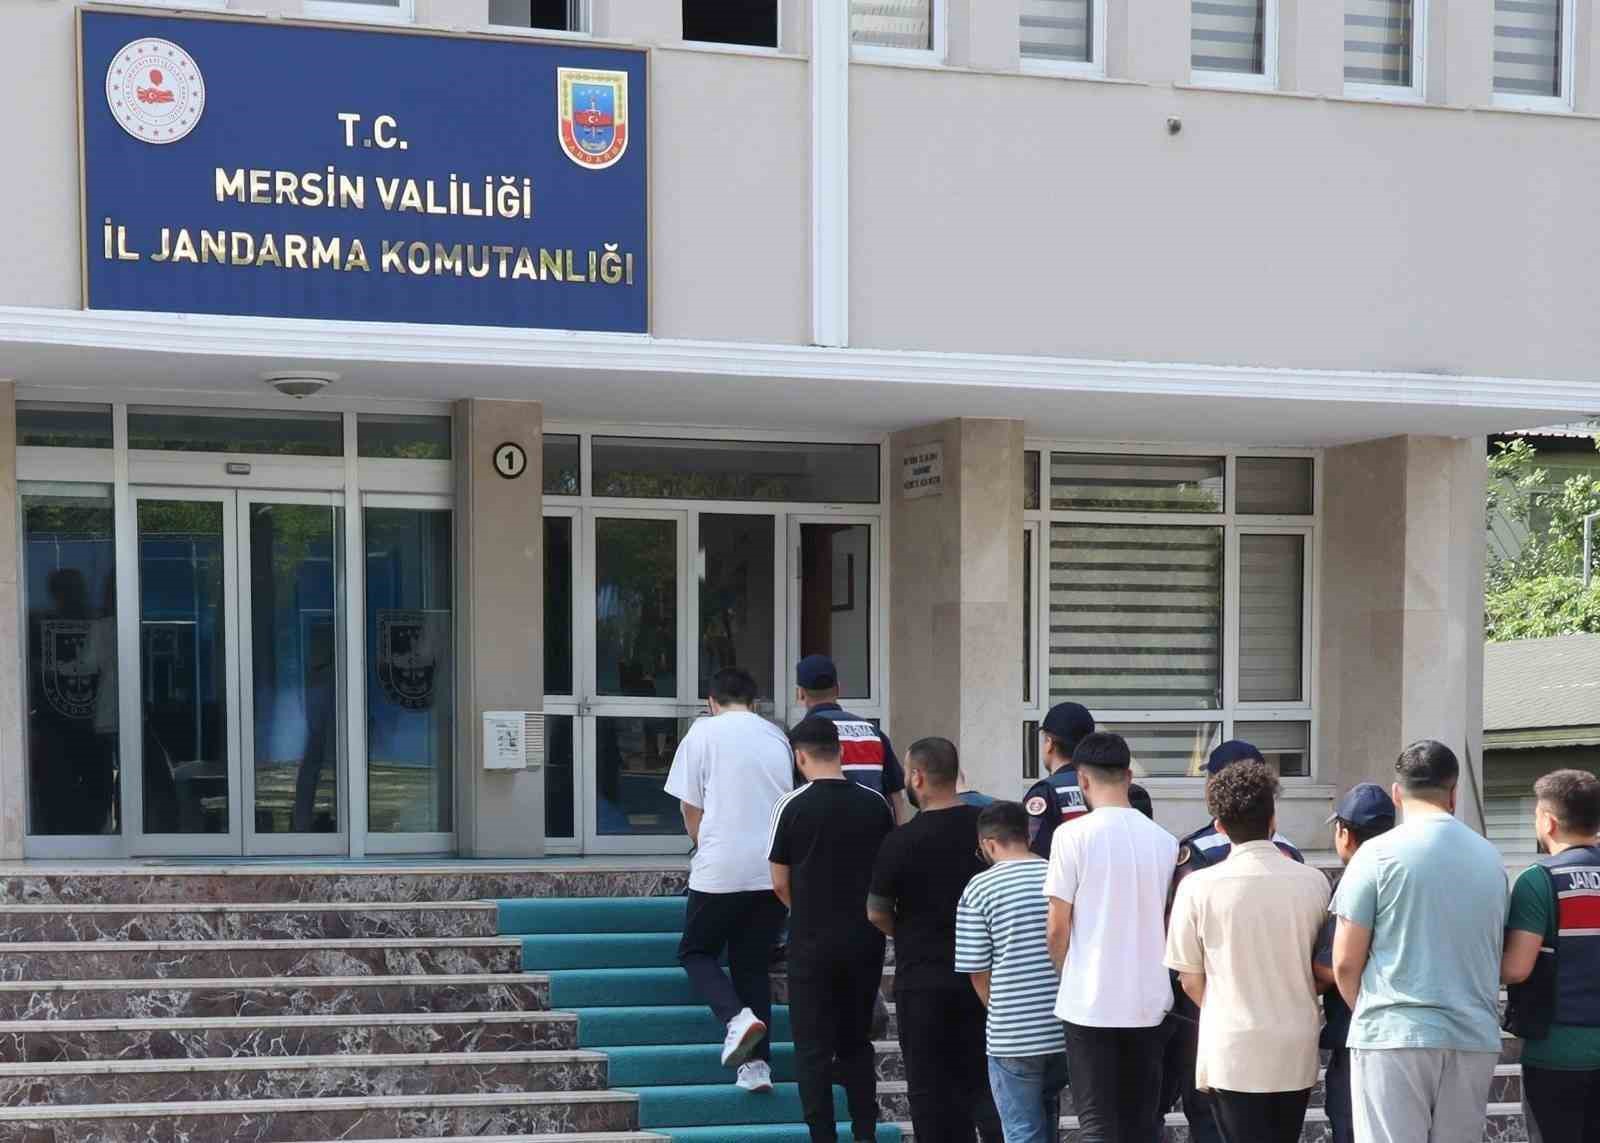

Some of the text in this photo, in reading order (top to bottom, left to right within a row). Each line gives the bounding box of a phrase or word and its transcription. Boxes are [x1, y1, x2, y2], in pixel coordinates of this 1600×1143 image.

[338, 112, 408, 150] T.C.
[215, 165, 531, 219] MERSİN VALİLİĞİ
[104, 217, 633, 285] İL JANDARMA KOMUTANLIĞI
[504, 450, 513, 470] 1
[1569, 871, 1600, 889] JAND
